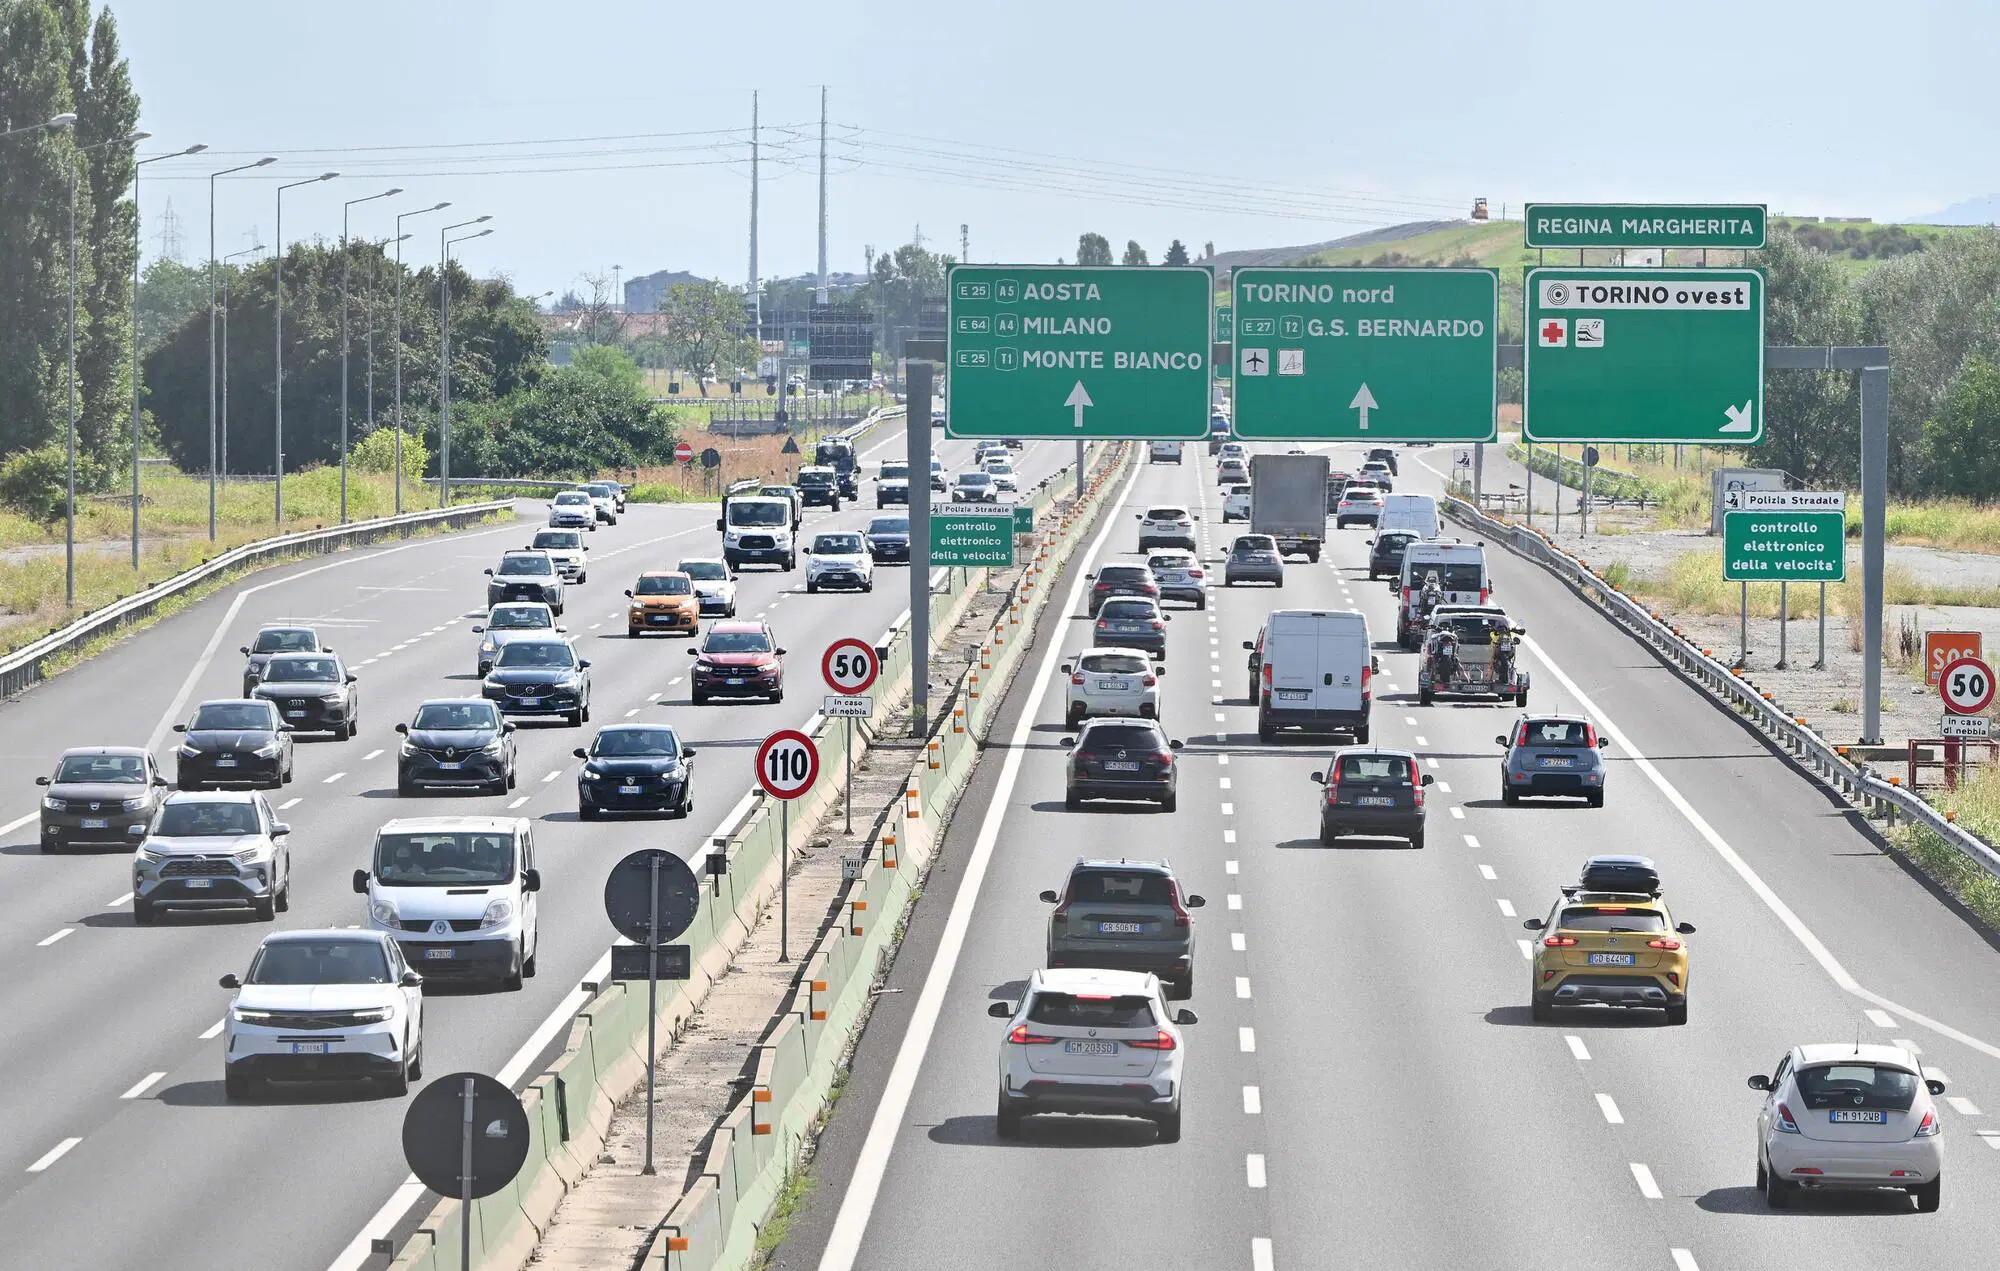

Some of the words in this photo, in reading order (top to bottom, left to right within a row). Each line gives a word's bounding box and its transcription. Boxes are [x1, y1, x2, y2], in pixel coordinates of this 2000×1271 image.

[1537, 218, 1613, 234] REGINA
[1622, 219, 1754, 235] MARGHERITA
[961, 286, 968, 296] E
[972, 286, 986, 296] 25
[1000, 286, 1015, 297] A5
[1024, 283, 1101, 301] AOSTA
[1242, 284, 1334, 303] TORINO
[1343, 285, 1394, 303] nord
[1576, 286, 1669, 304] TORINO
[1676, 287, 1744, 305] ovest
[960, 320, 967, 330] E
[971, 320, 986, 330] 64
[1000, 320, 1014, 331] A4
[1023, 317, 1112, 335] MILANO
[1245, 322, 1253, 332] E
[1256, 322, 1271, 332] 27
[1286, 321, 1298, 333] T2
[1307, 319, 1349, 337] G.S.
[1358, 319, 1484, 337] BERNARDO
[960, 354, 967, 364] E
[971, 354, 985, 364] 25
[1001, 353, 1012, 365] T1
[1023, 351, 1104, 369] MONTE
[1114, 351, 1202, 370] BIANCO
[1749, 496, 1786, 505] Polizia
[1791, 496, 1839, 505] Stradale
[945, 522, 996, 531] controllo
[1751, 522, 1818, 533] controllo
[940, 537, 1001, 546] elettronico
[1743, 541, 1825, 552] elettronico
[931, 551, 958, 560] della
[1732, 560, 1768, 570] della
[834, 654, 867, 678] 50
[1952, 674, 1985, 698] 50
[1948, 717, 1957, 726] in
[1956, 727, 1987, 736] nebbia
[769, 749, 808, 781] 110
[1071, 1042, 1082, 1053] GM
[1085, 1043, 1112, 1053] 203SD
[1836, 1111, 1848, 1120] FM
[1851, 1112, 1880, 1121] 912WB
